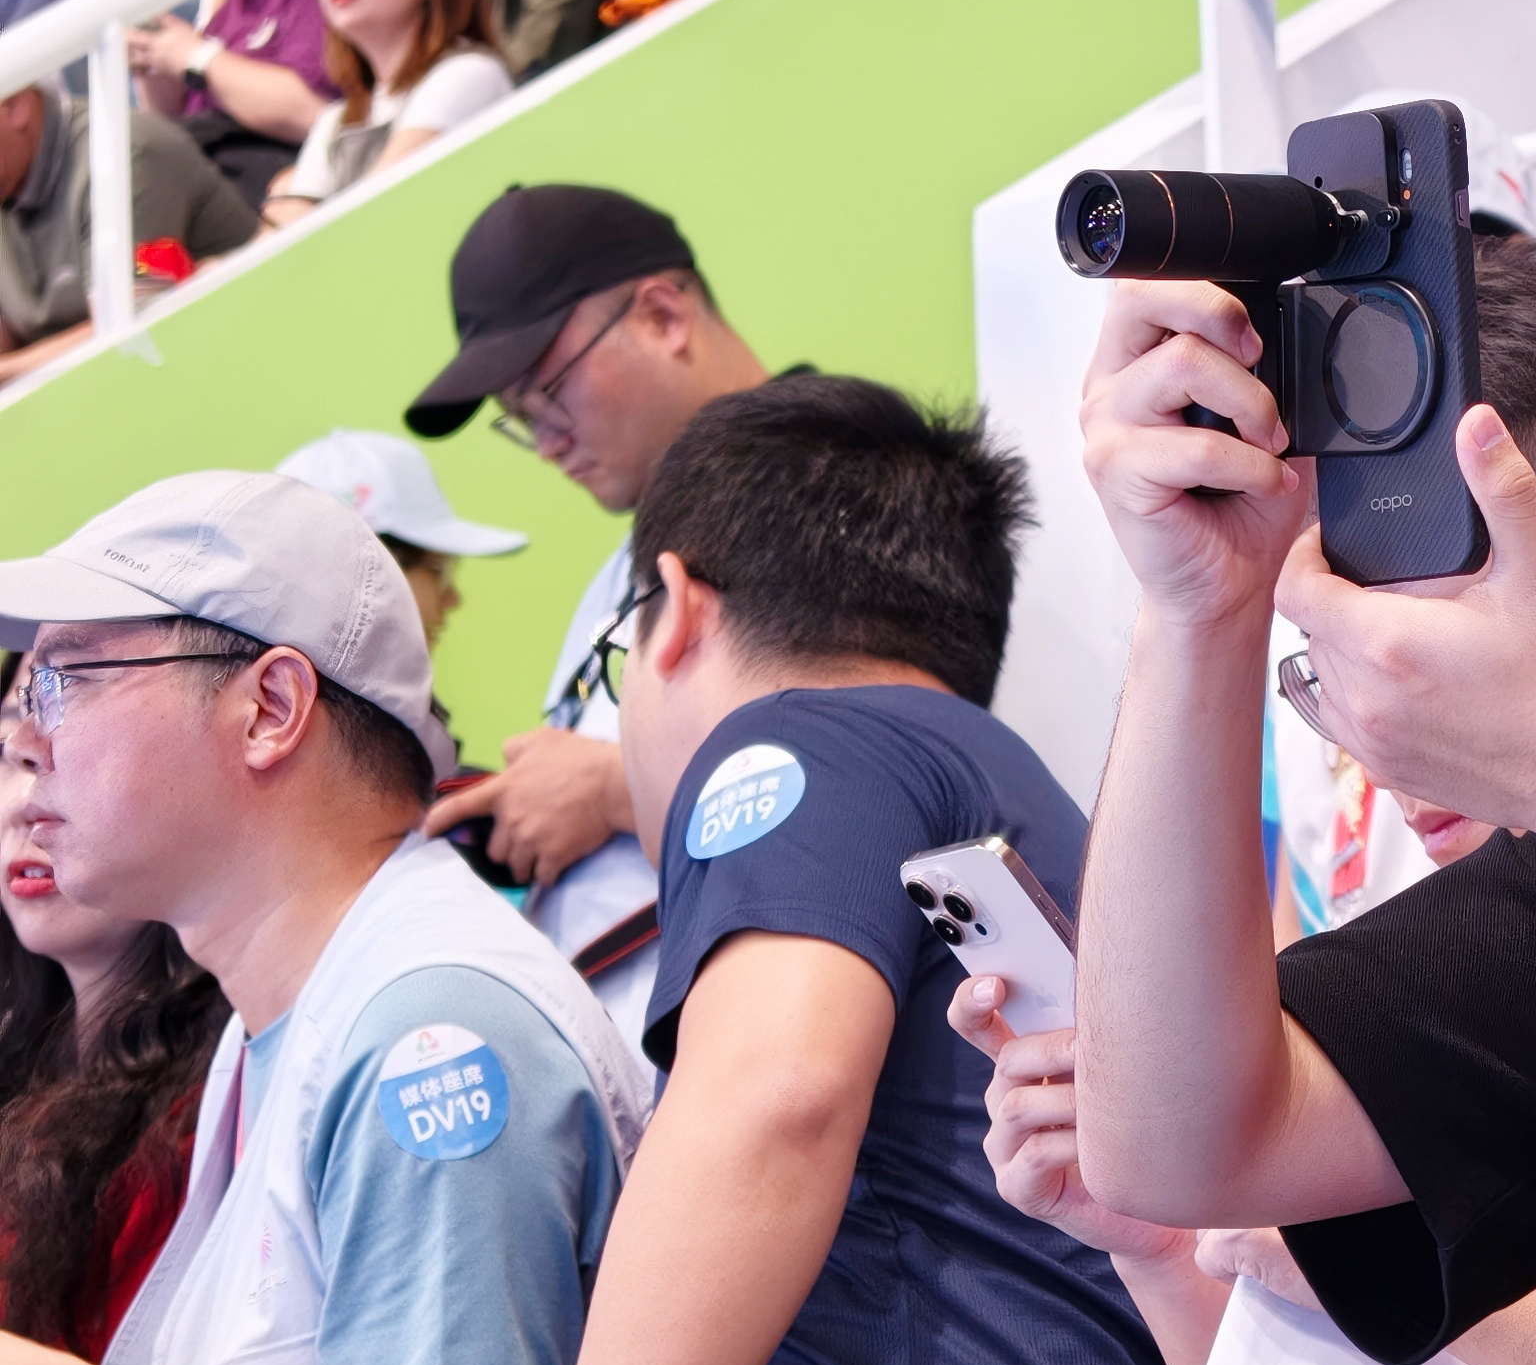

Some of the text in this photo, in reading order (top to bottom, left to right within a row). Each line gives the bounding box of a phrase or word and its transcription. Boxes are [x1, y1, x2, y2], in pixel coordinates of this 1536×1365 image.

[700, 795, 777, 848] DV19
[703, 777, 781, 822] 媒体座席
[399, 1063, 484, 1110] 媒体座席
[408, 1089, 491, 1143] DV19
